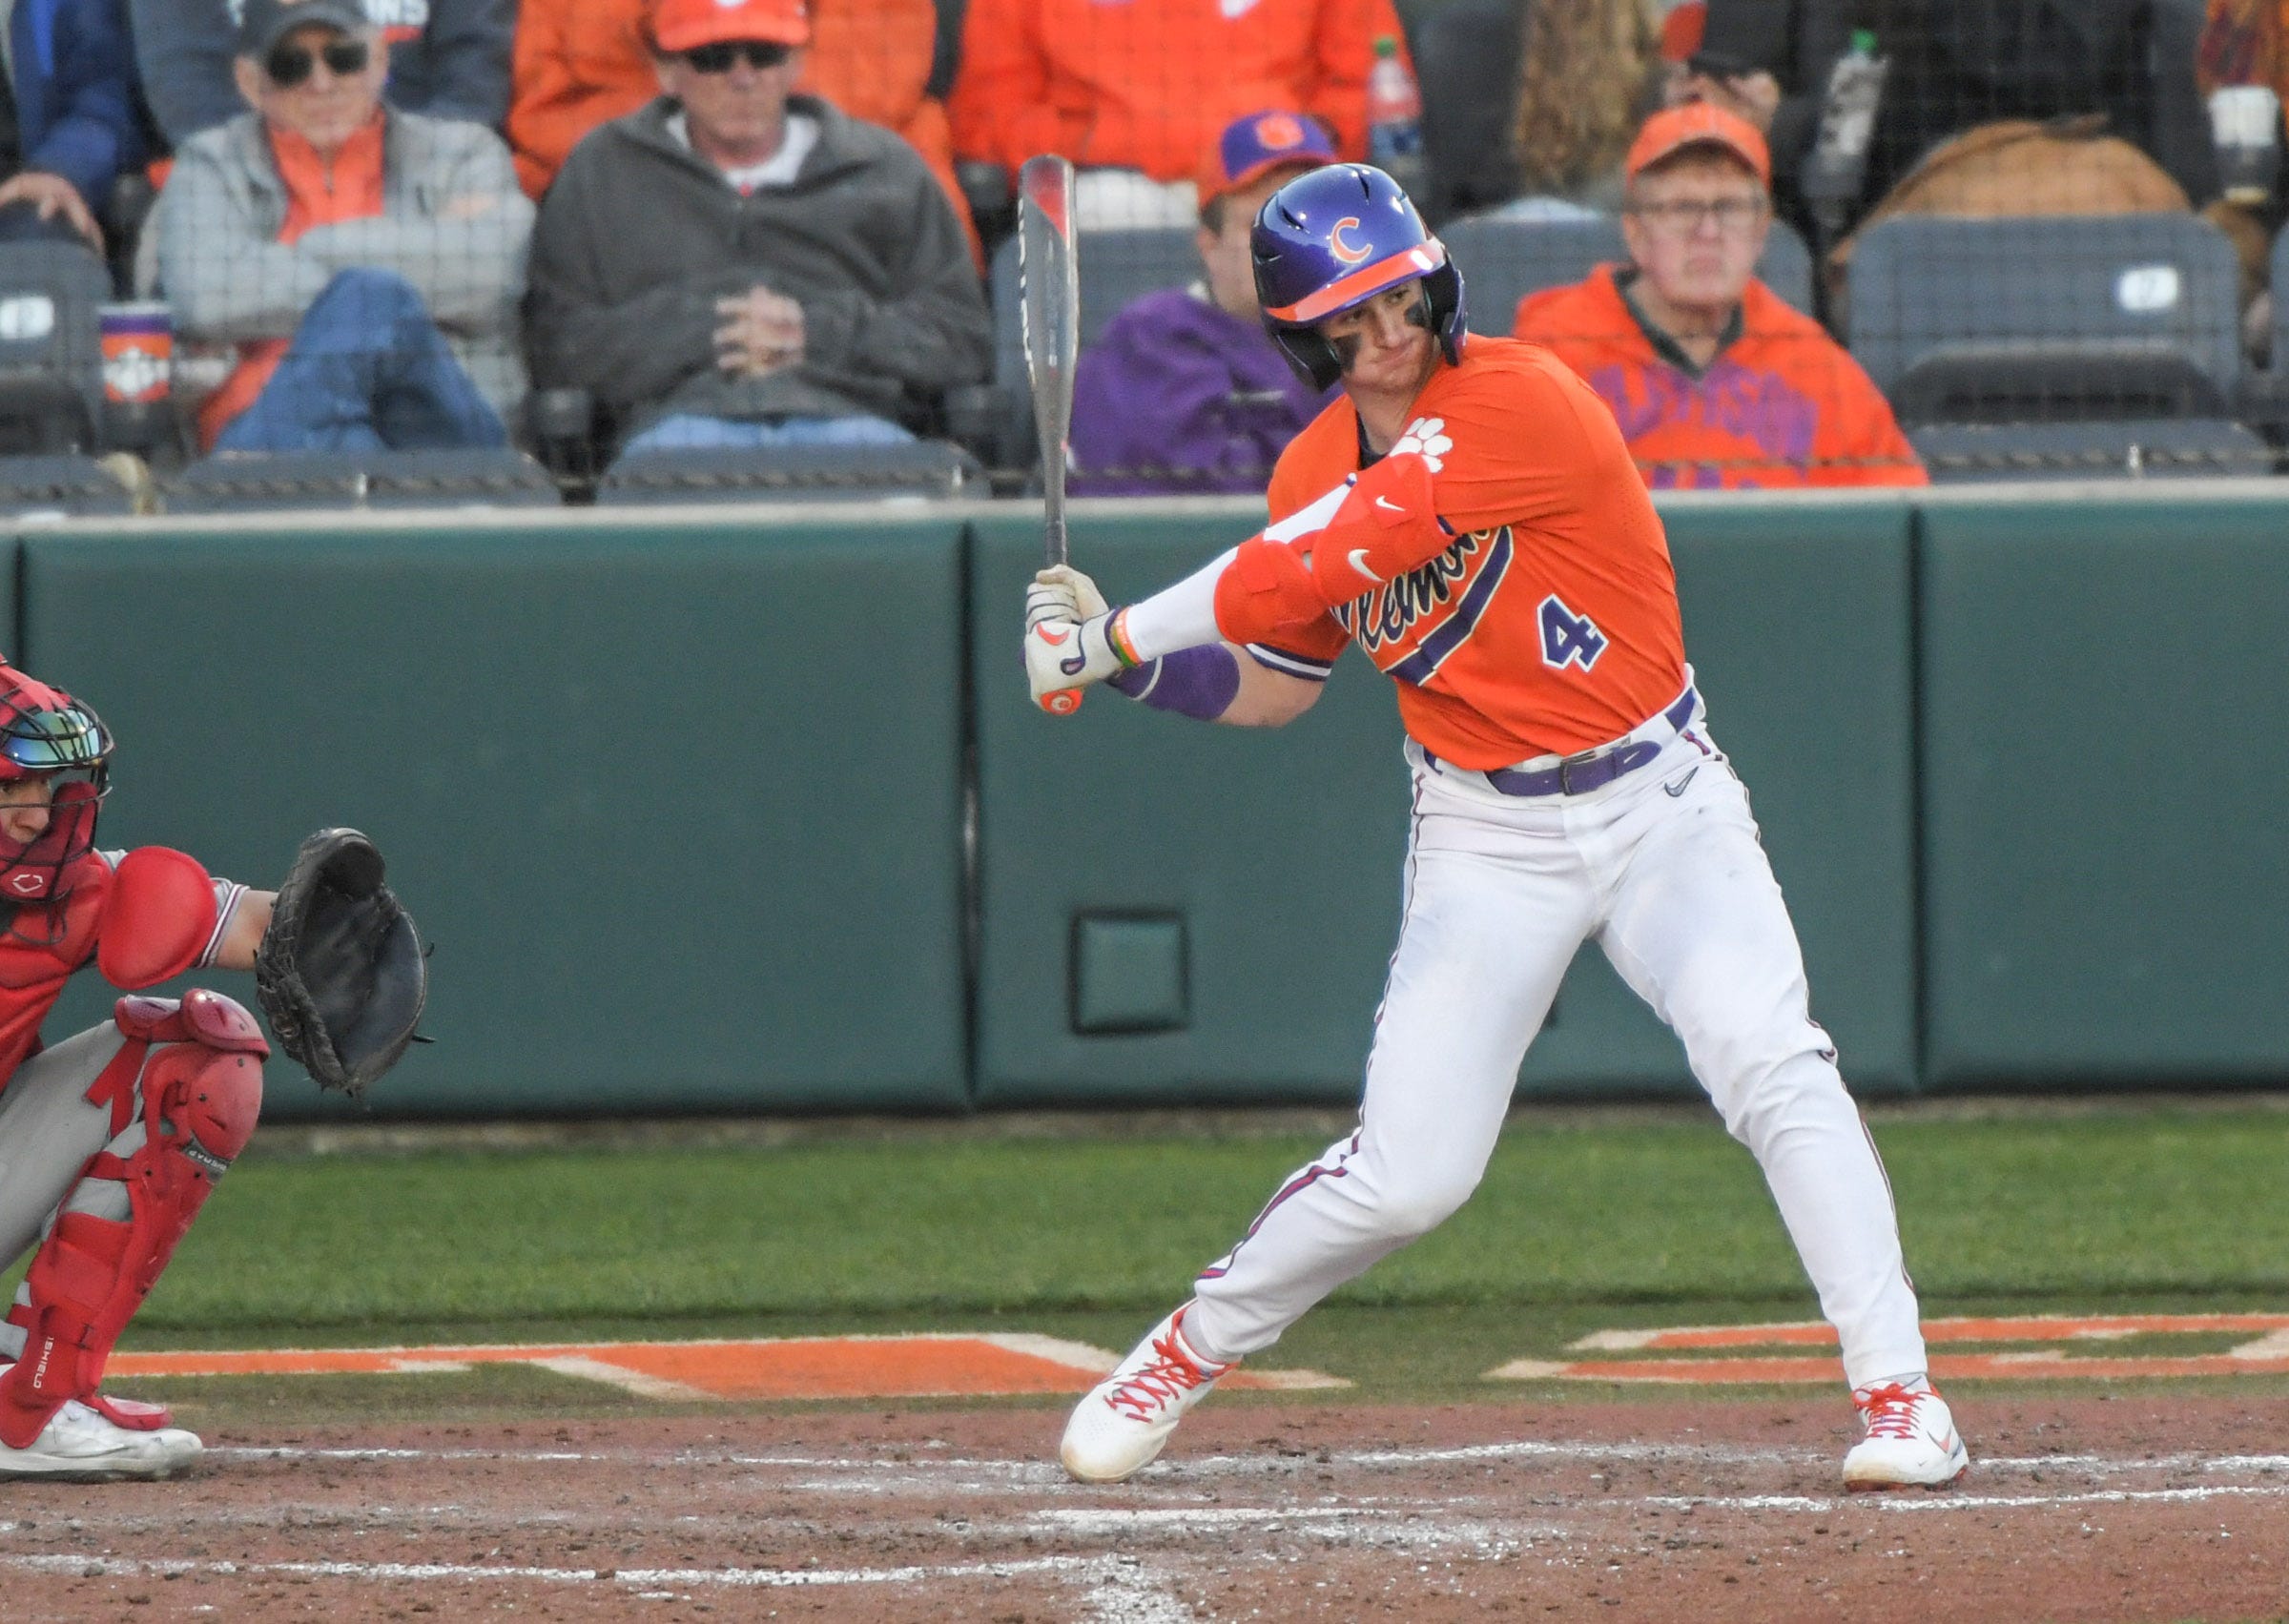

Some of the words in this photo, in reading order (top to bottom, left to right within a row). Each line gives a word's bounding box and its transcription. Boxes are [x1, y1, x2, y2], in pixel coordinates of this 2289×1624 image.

[1330, 216, 1373, 263] C
[1536, 592, 1610, 673] 4
[33, 1336, 54, 1388] SHIELD
